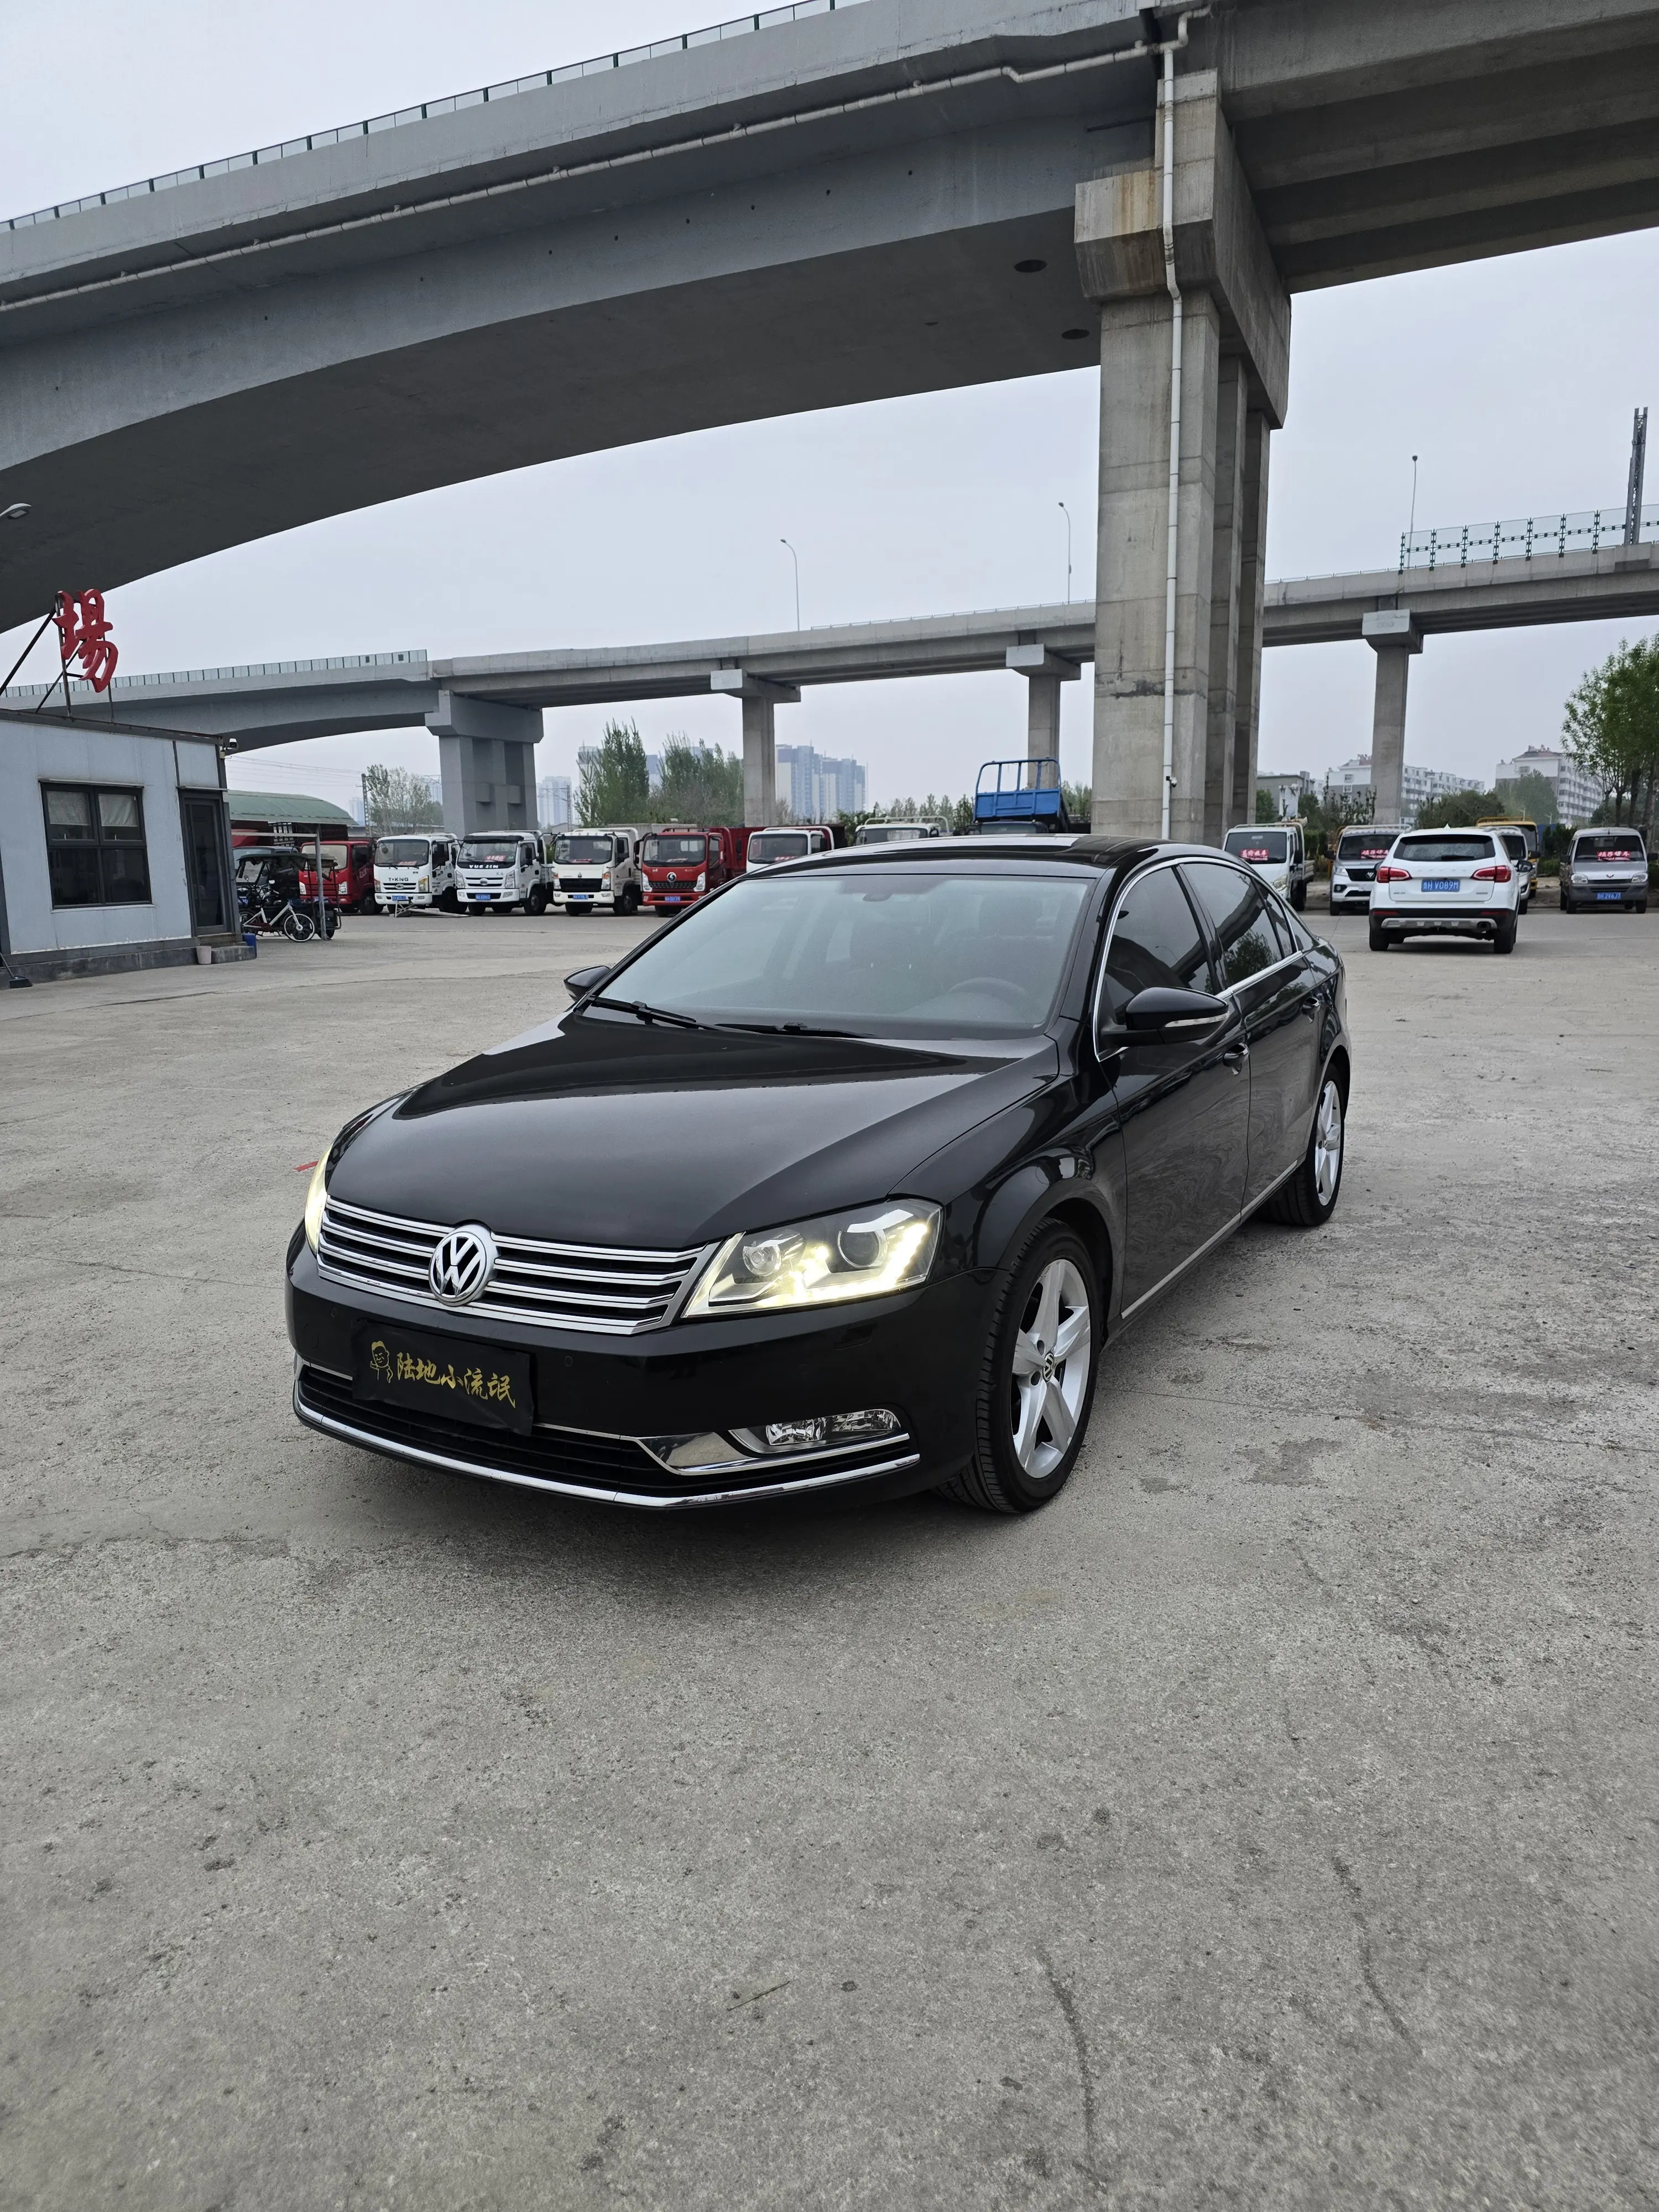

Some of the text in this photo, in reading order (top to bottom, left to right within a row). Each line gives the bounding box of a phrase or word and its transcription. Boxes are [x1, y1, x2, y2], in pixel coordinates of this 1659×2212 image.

[431, 1231, 487, 1299] VW
[397, 1352, 516, 1408] 陆地小流氓
